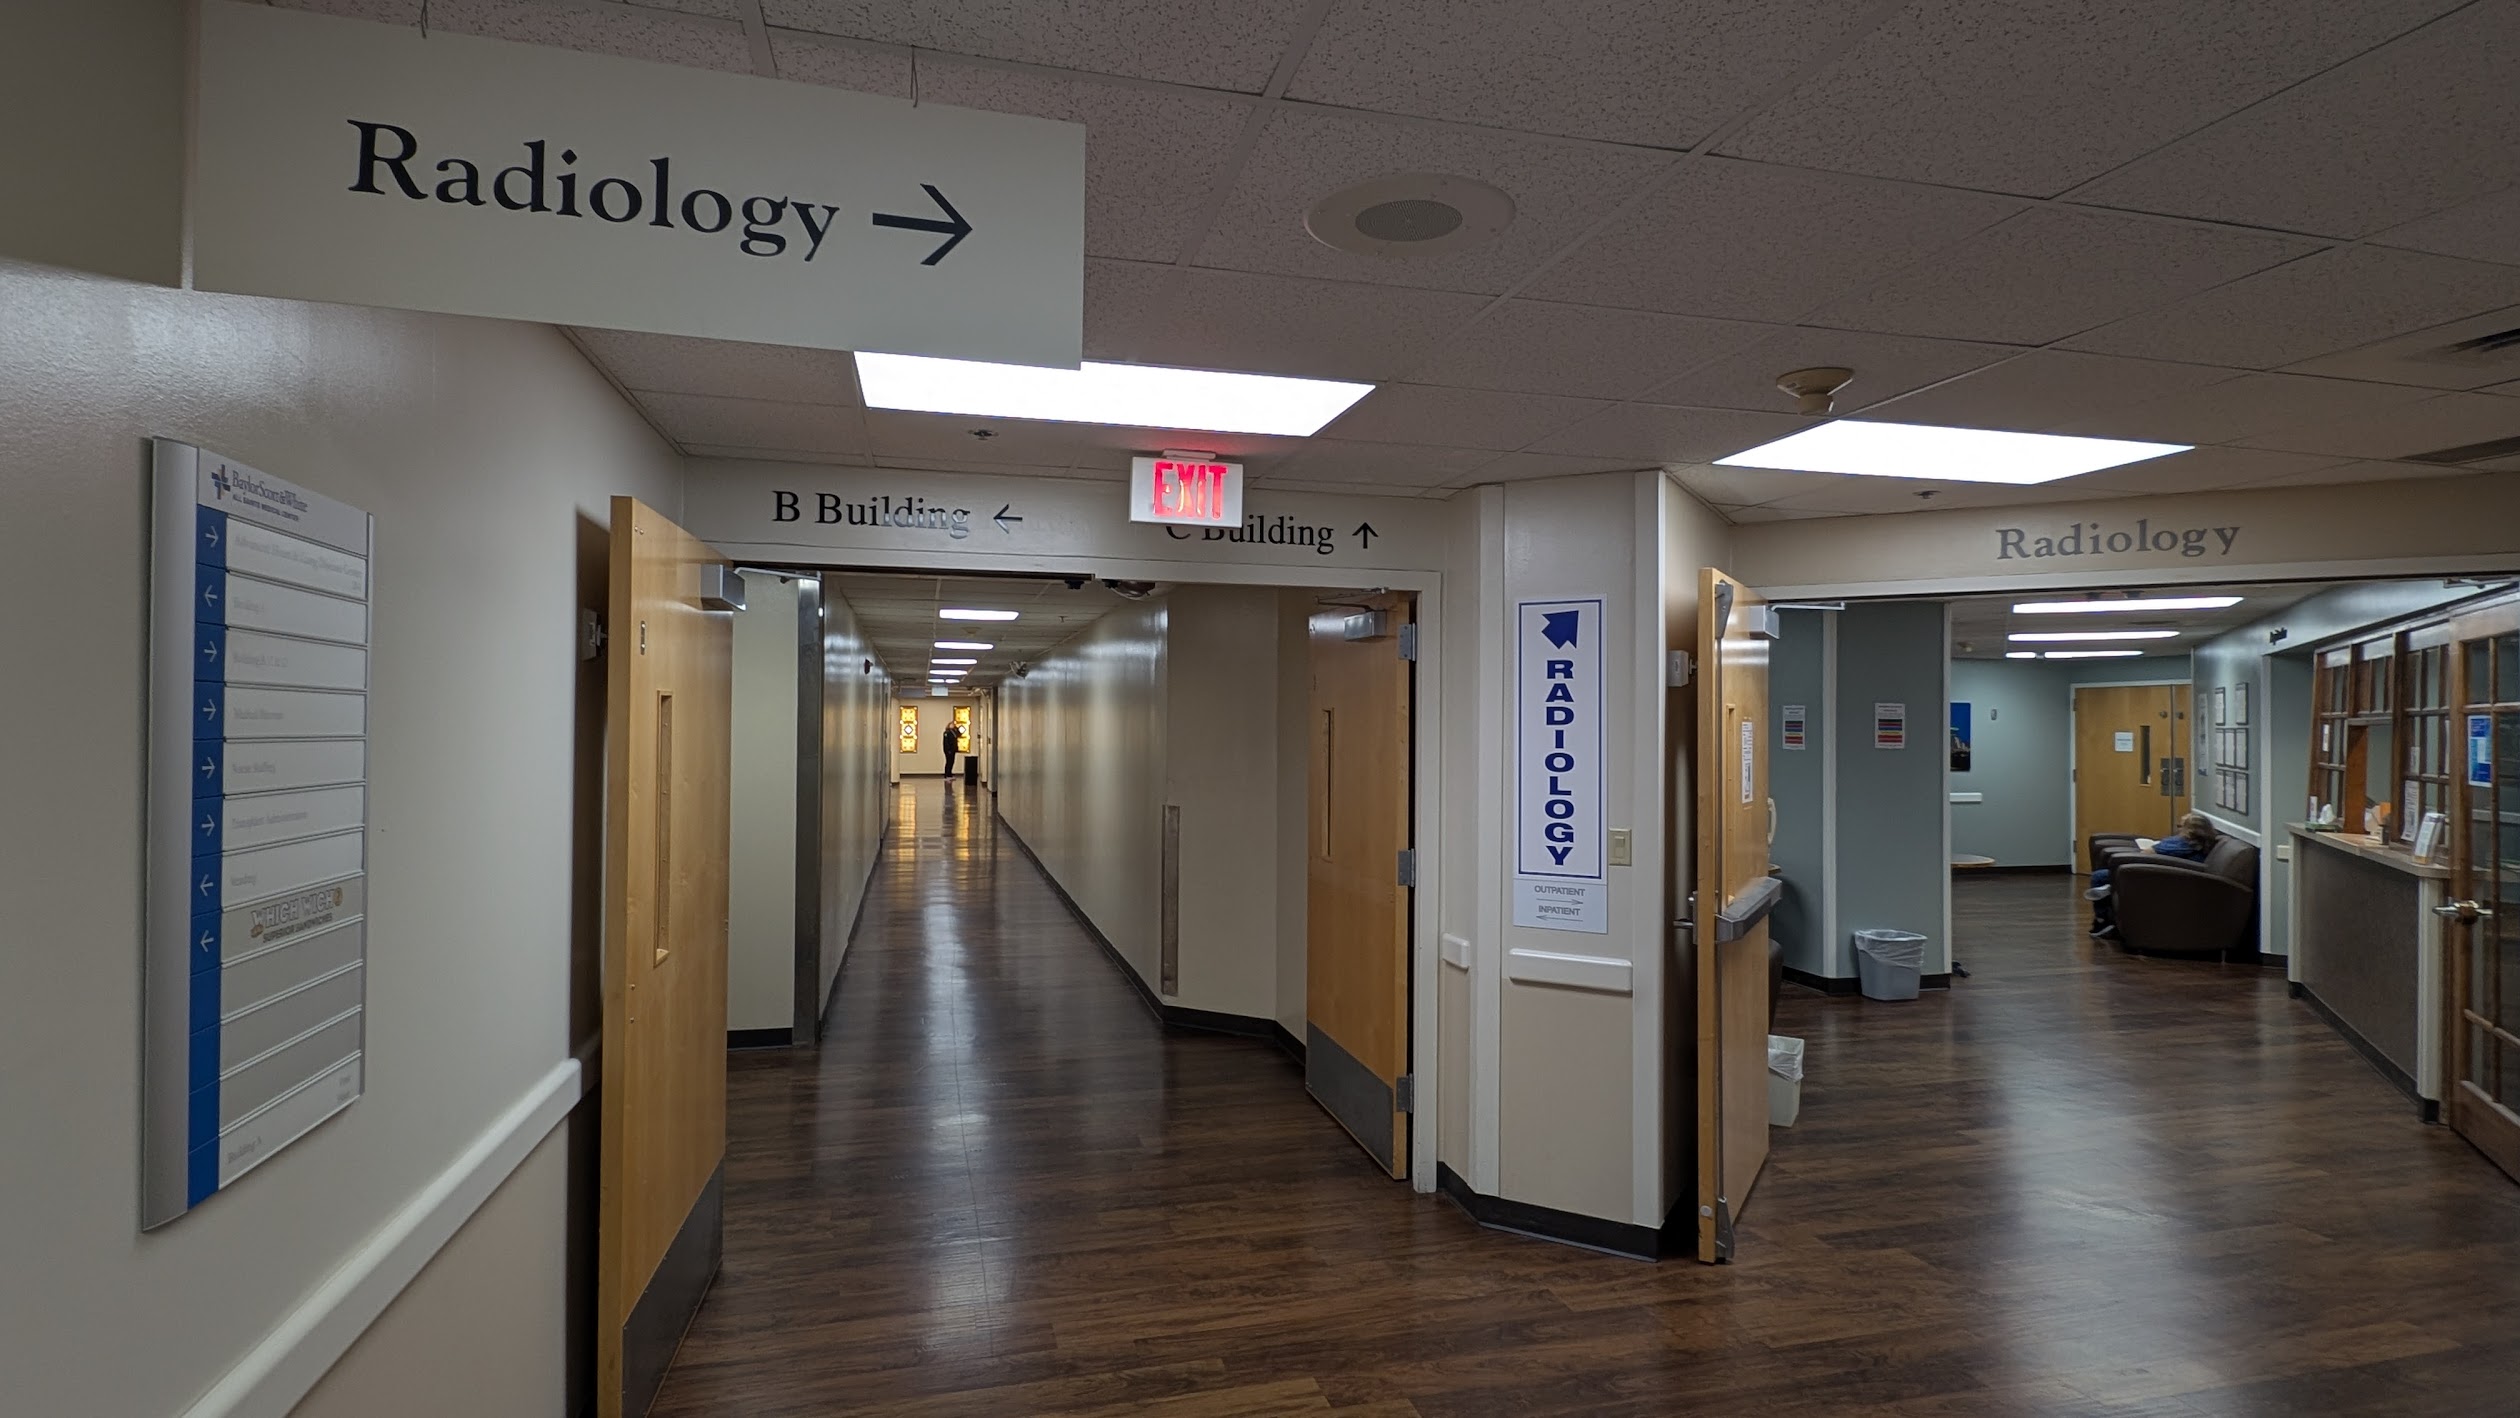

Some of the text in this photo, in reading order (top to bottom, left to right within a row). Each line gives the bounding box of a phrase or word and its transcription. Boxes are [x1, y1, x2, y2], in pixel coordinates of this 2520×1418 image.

[347, 118, 840, 262] Radiology
[1153, 461, 1227, 519] EXIT
[772, 490, 971, 540] B Building
[1996, 518, 2240, 560] Radiology
[1545, 660, 1574, 865] RADIOLOGY
[250, 898, 299, 928] WHICH
[1534, 885, 1585, 897] OUTPATIENT
[1538, 905, 1581, 916] INPATIENT
